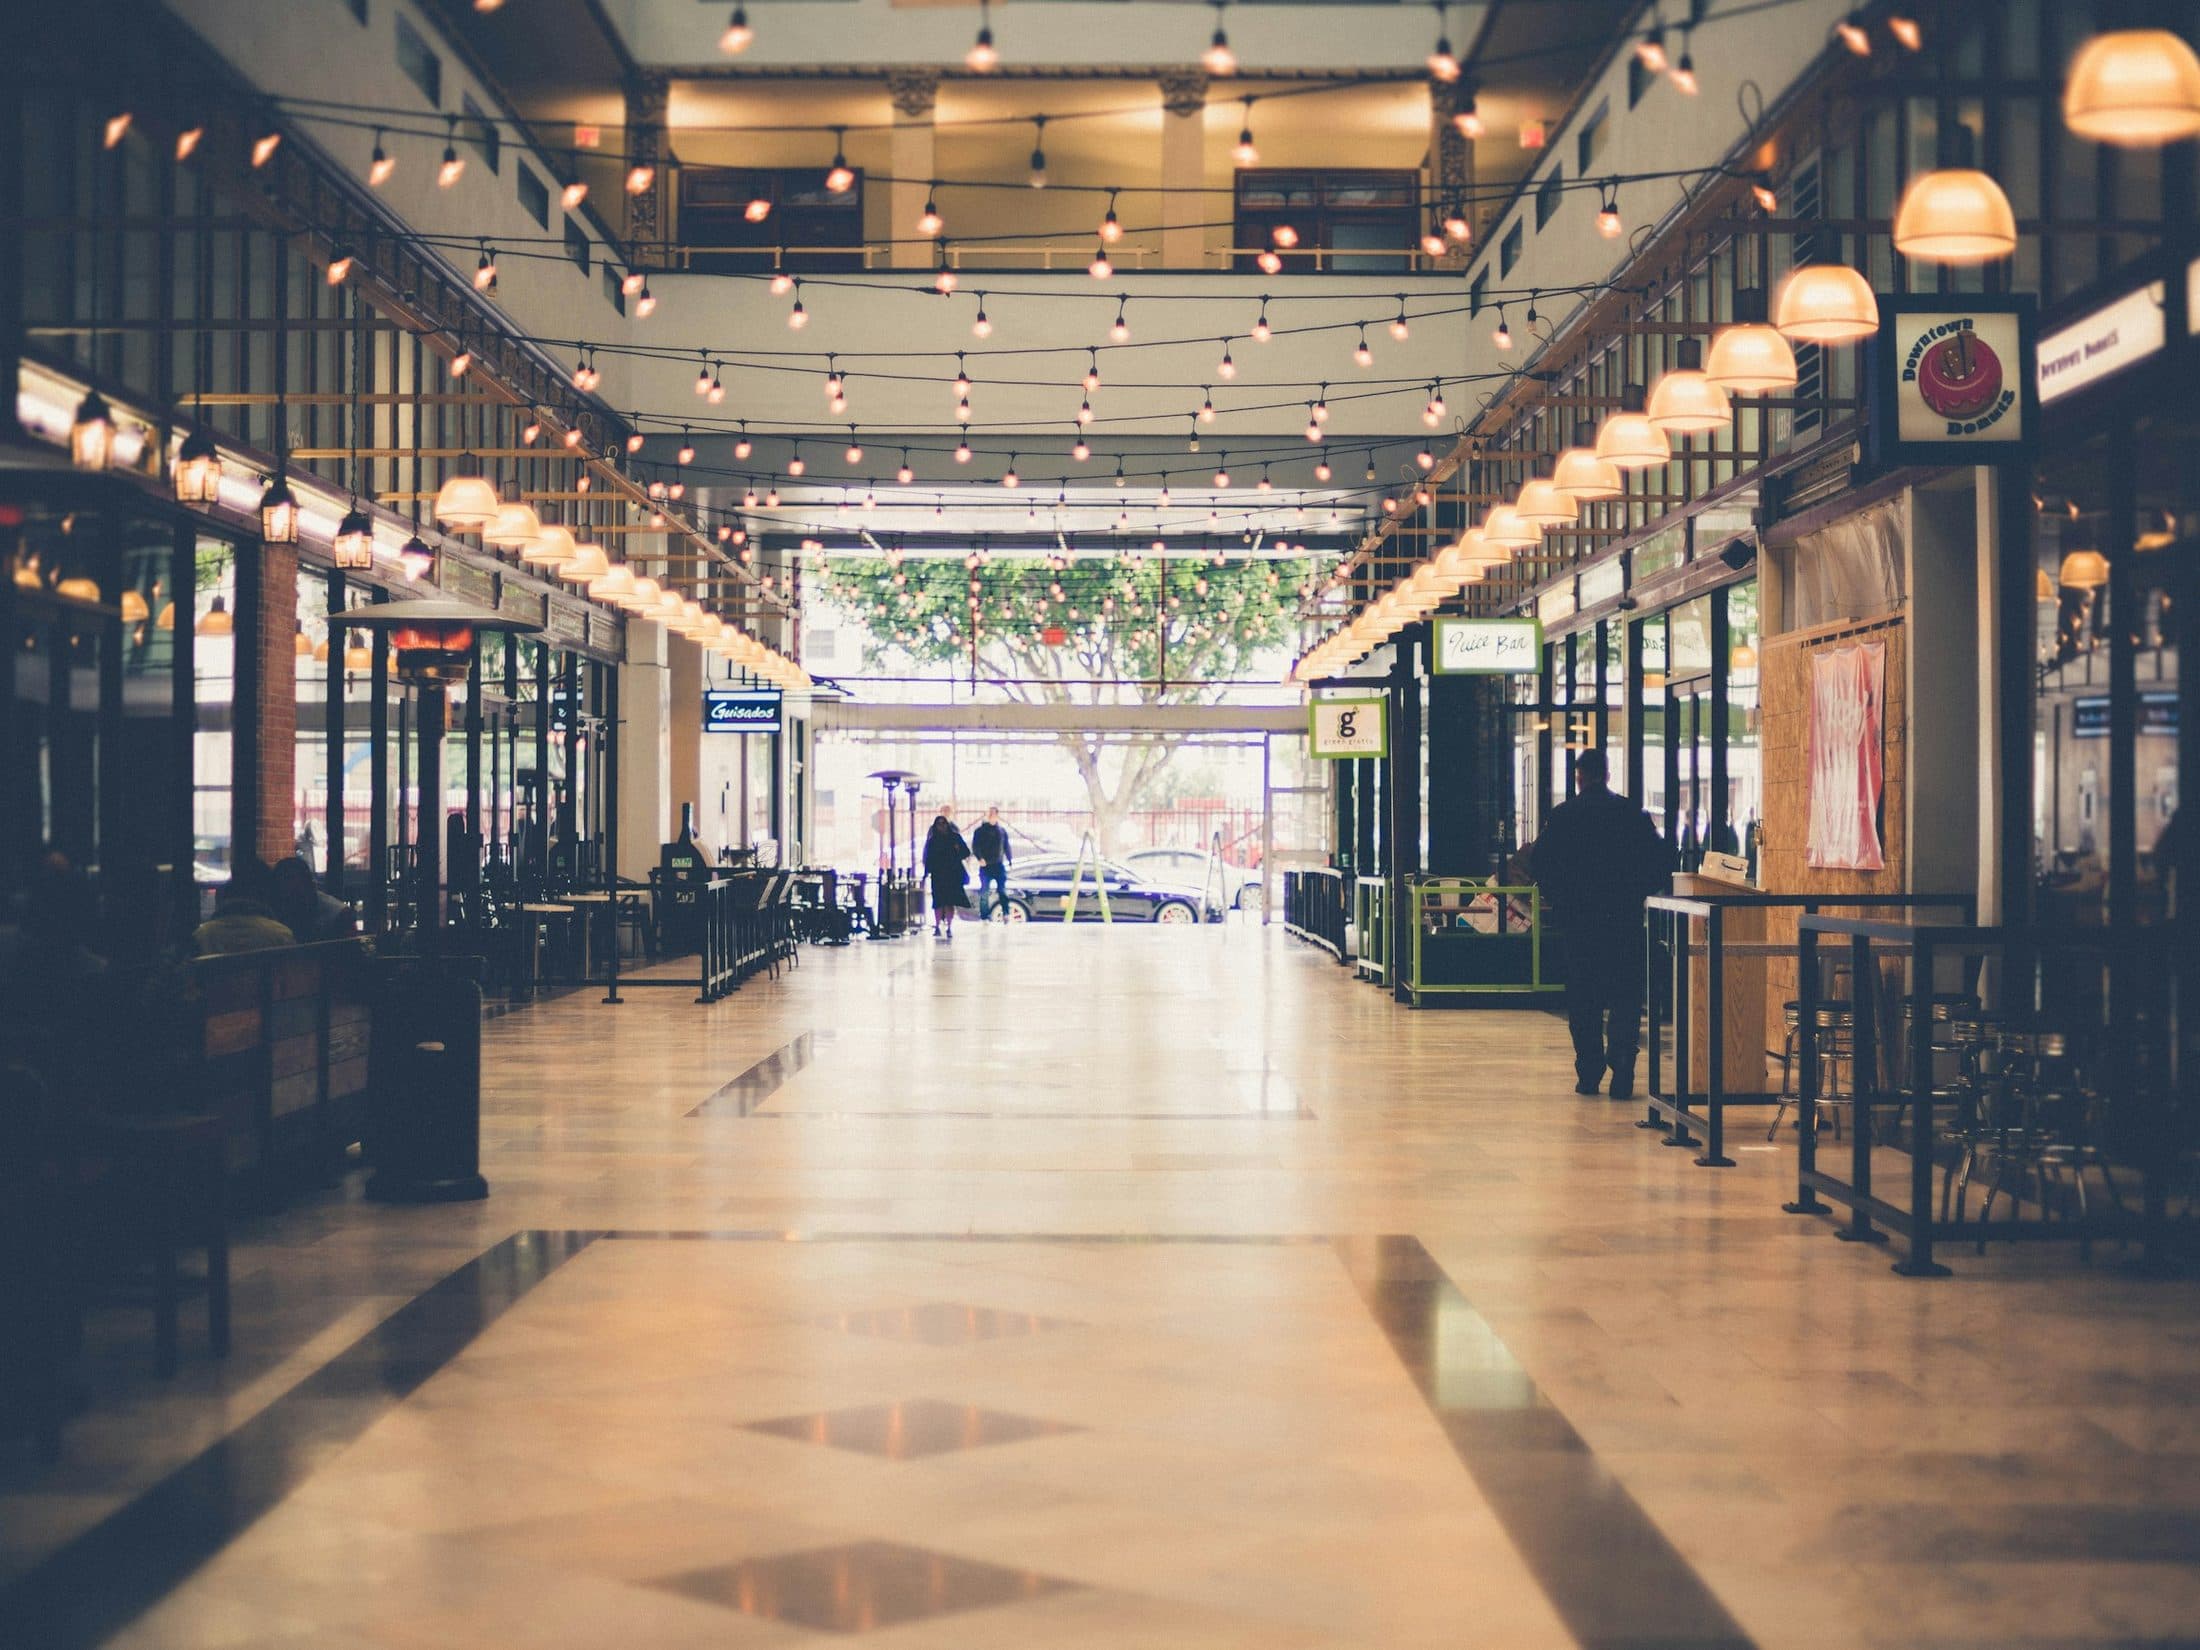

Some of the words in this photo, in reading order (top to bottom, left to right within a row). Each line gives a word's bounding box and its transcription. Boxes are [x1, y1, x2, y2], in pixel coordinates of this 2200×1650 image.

[1902, 318, 1973, 381] Downtown
[1947, 390, 2015, 435] Donuts
[1496, 634, 1528, 657] Bar
[711, 701, 775, 719] Guisados
[1340, 711, 1356, 737] g
